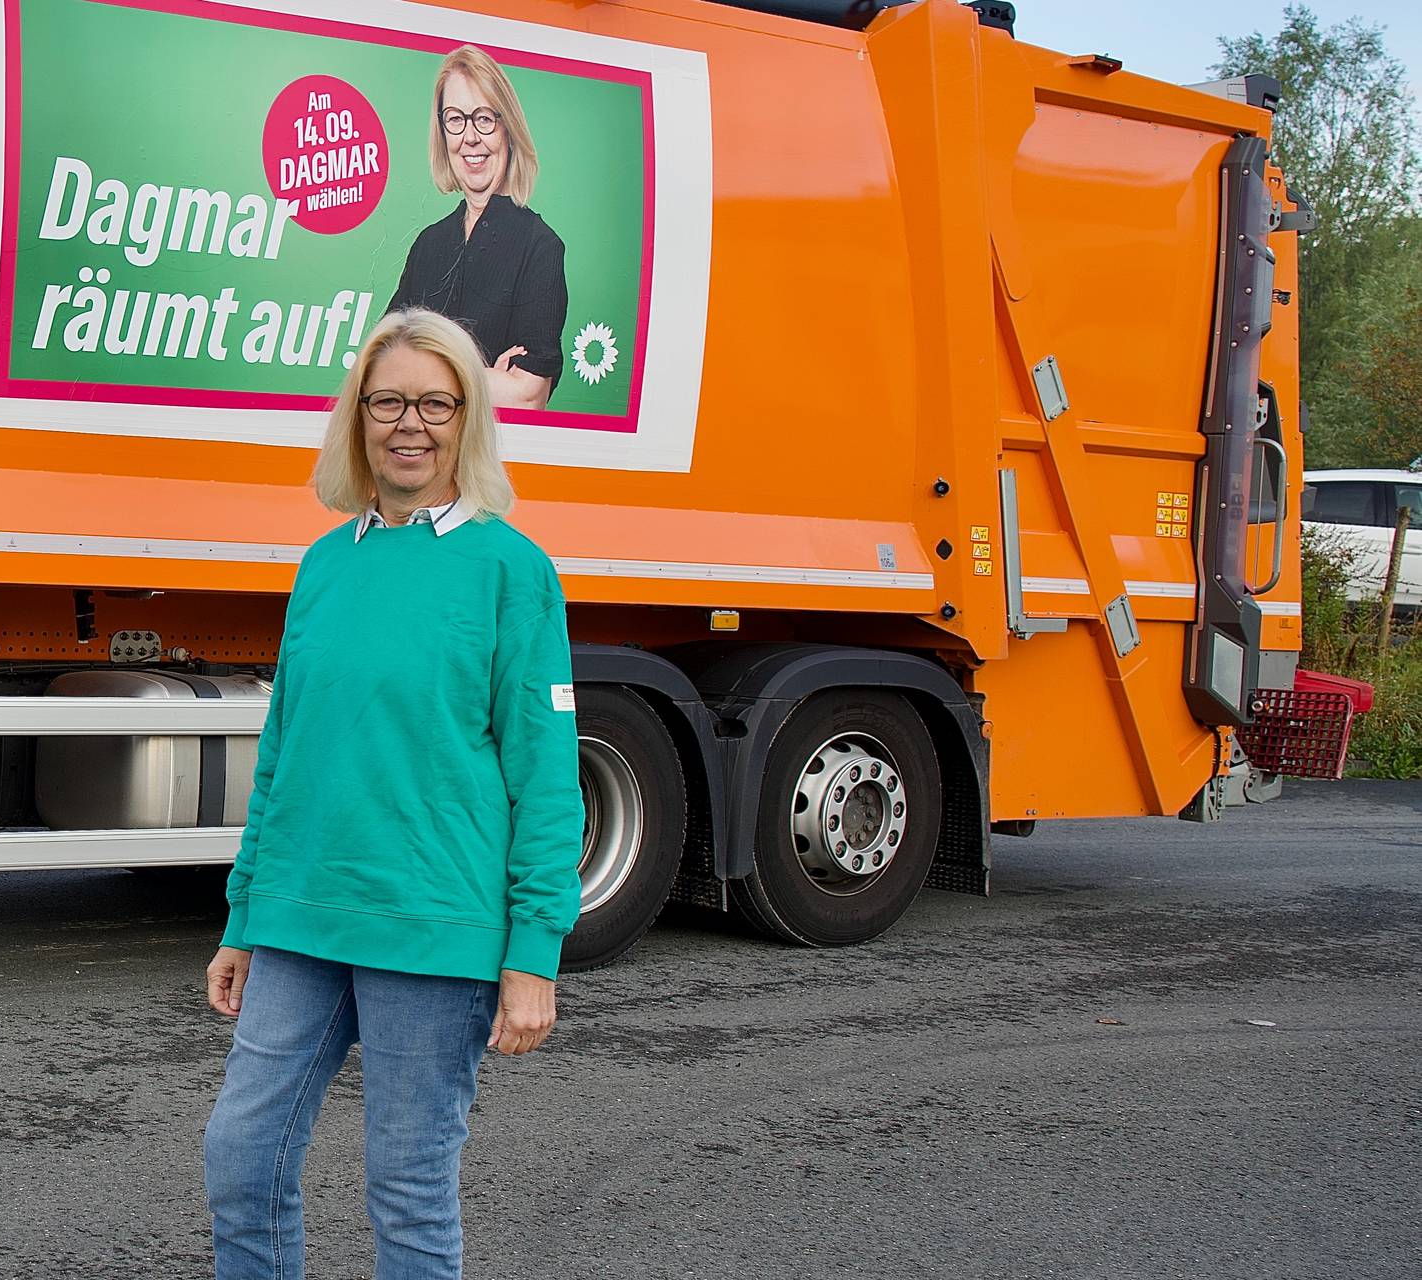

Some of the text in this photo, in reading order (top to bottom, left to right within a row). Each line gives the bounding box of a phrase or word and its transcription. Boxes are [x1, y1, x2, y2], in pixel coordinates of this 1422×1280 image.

[307, 91, 331, 112] Am
[293, 109, 360, 149] 14.09.
[280, 142, 380, 191] DAGMAR
[38, 156, 300, 267] Dagmar
[307, 181, 363, 212] wählen!
[31, 266, 374, 370] räumt auf!
